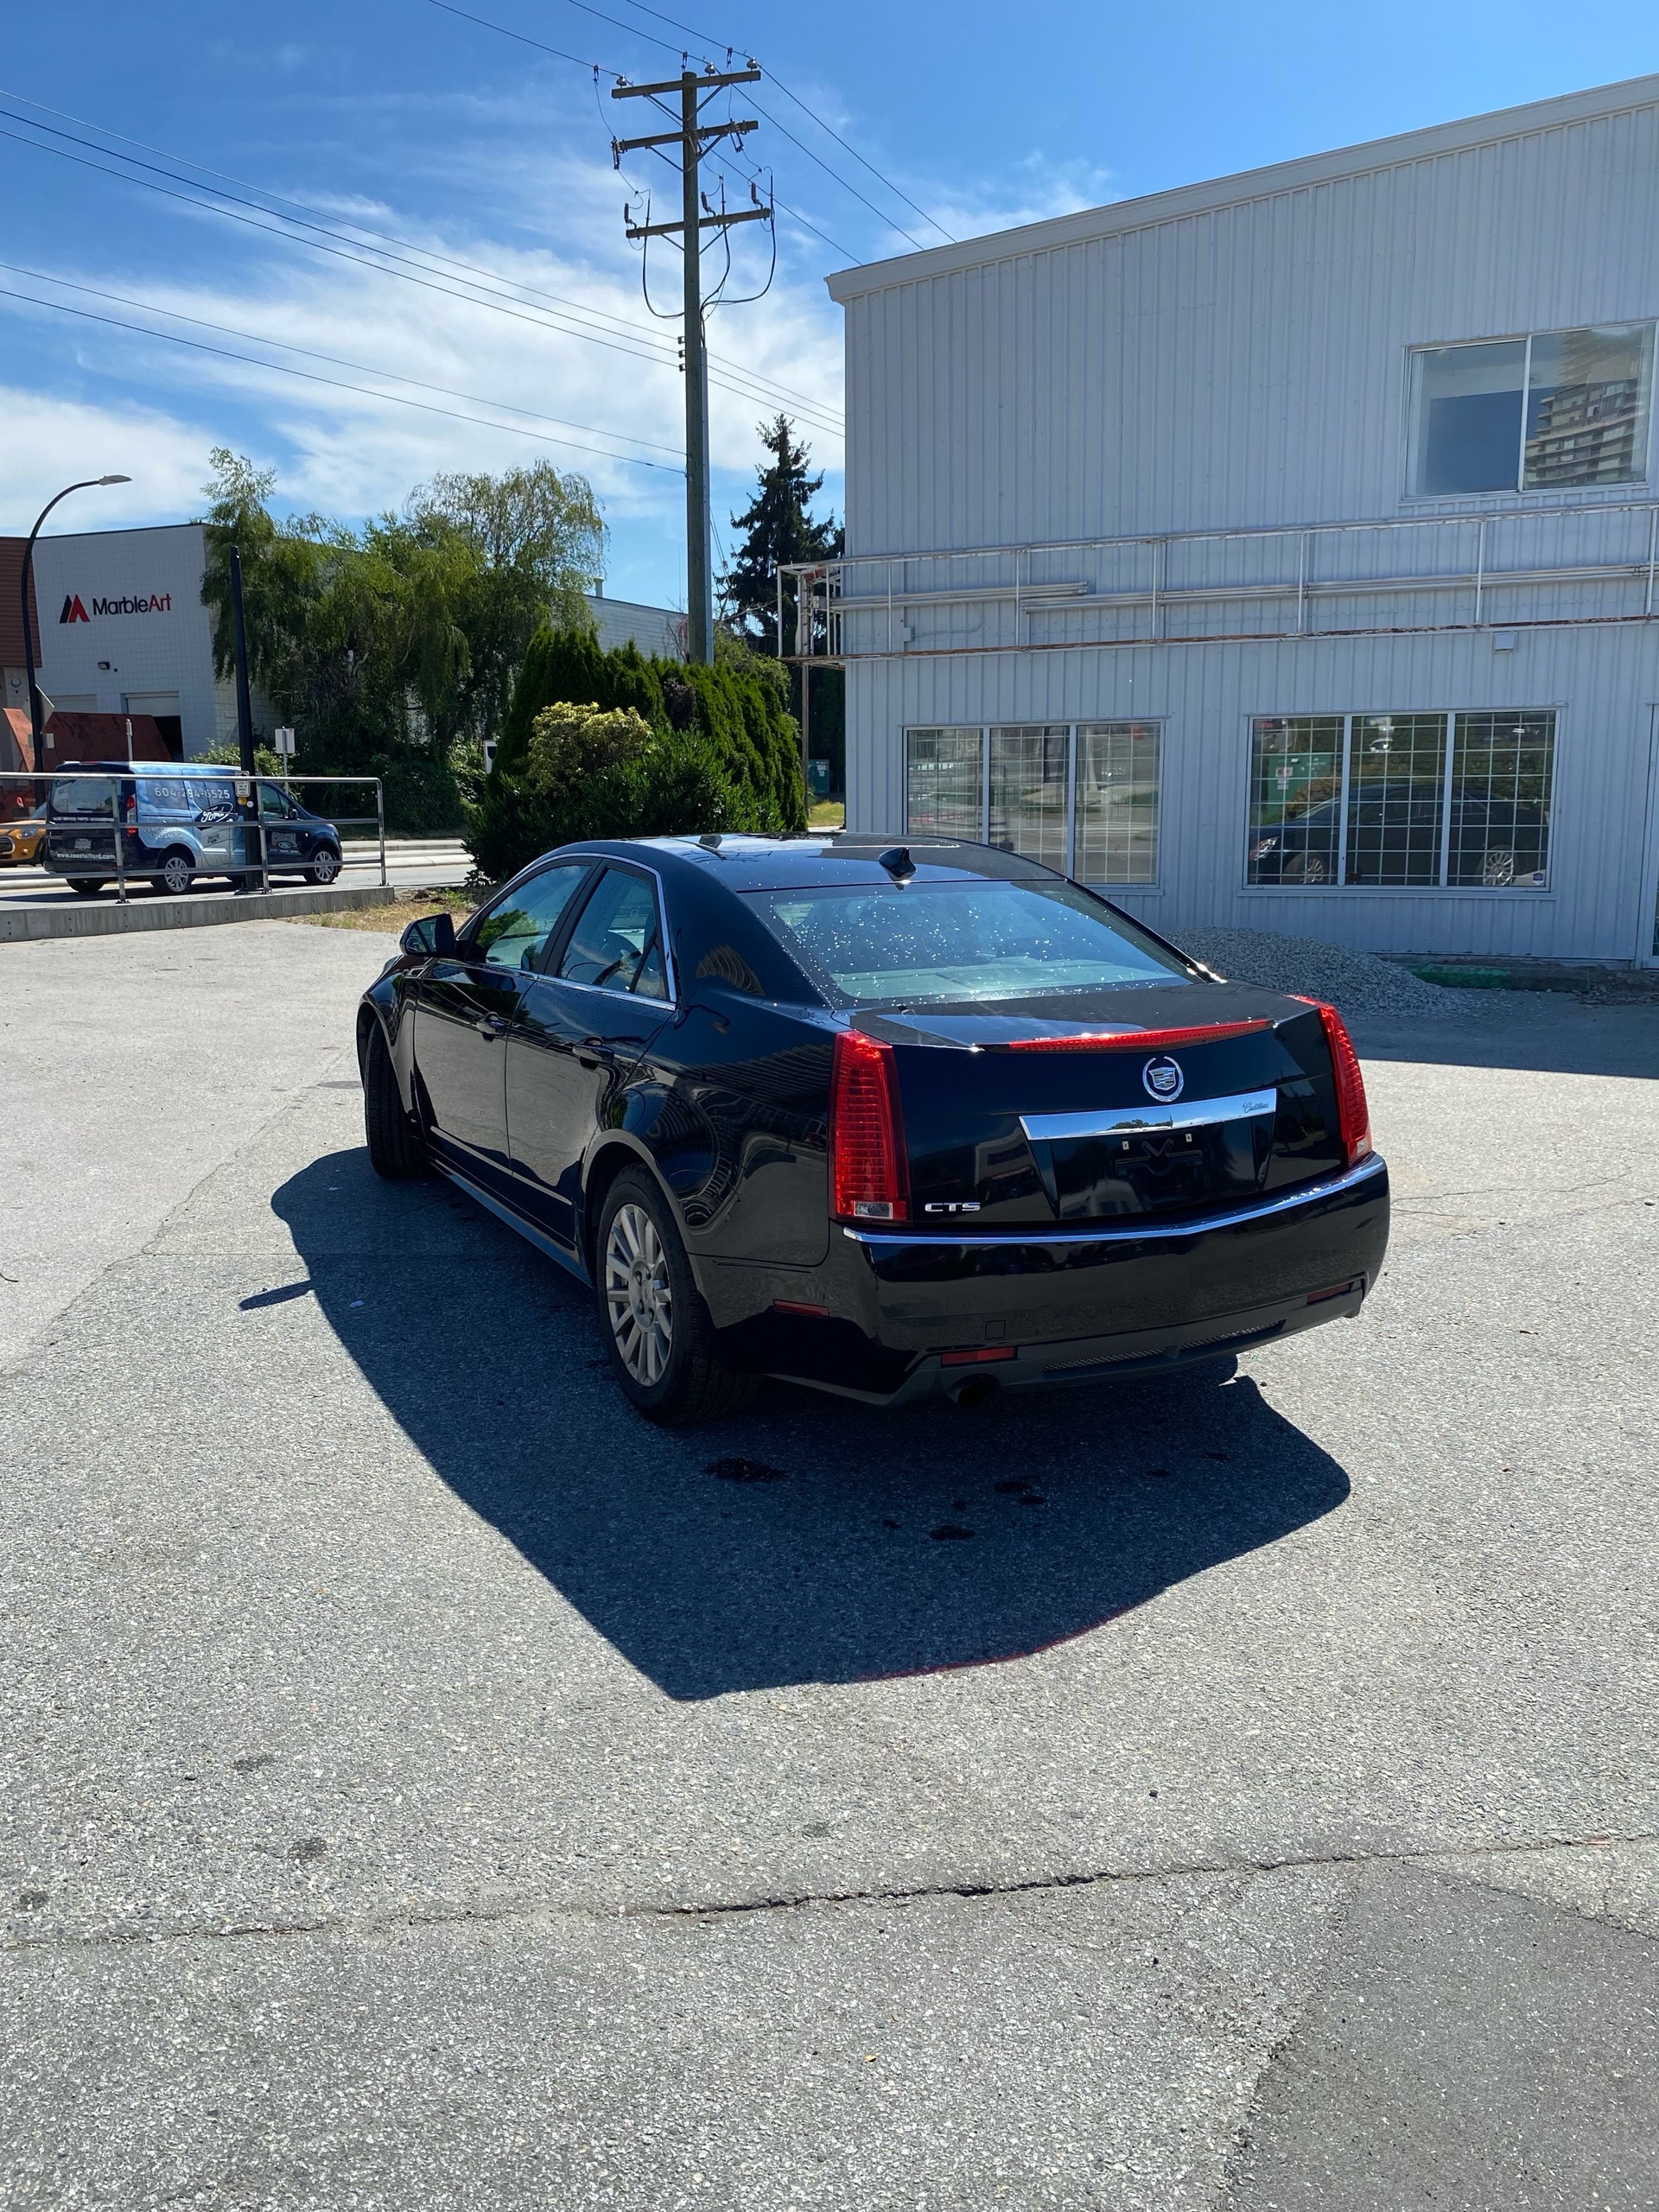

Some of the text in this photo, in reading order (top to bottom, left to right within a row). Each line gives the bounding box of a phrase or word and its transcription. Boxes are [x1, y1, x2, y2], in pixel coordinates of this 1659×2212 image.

[92, 594, 171, 615] MarbleArt
[155, 786, 231, 799] 604-294-6525
[200, 805, 226, 823] Ford
[1243, 1102, 1269, 1113] Cadillac
[925, 1202, 981, 1211] CTS
